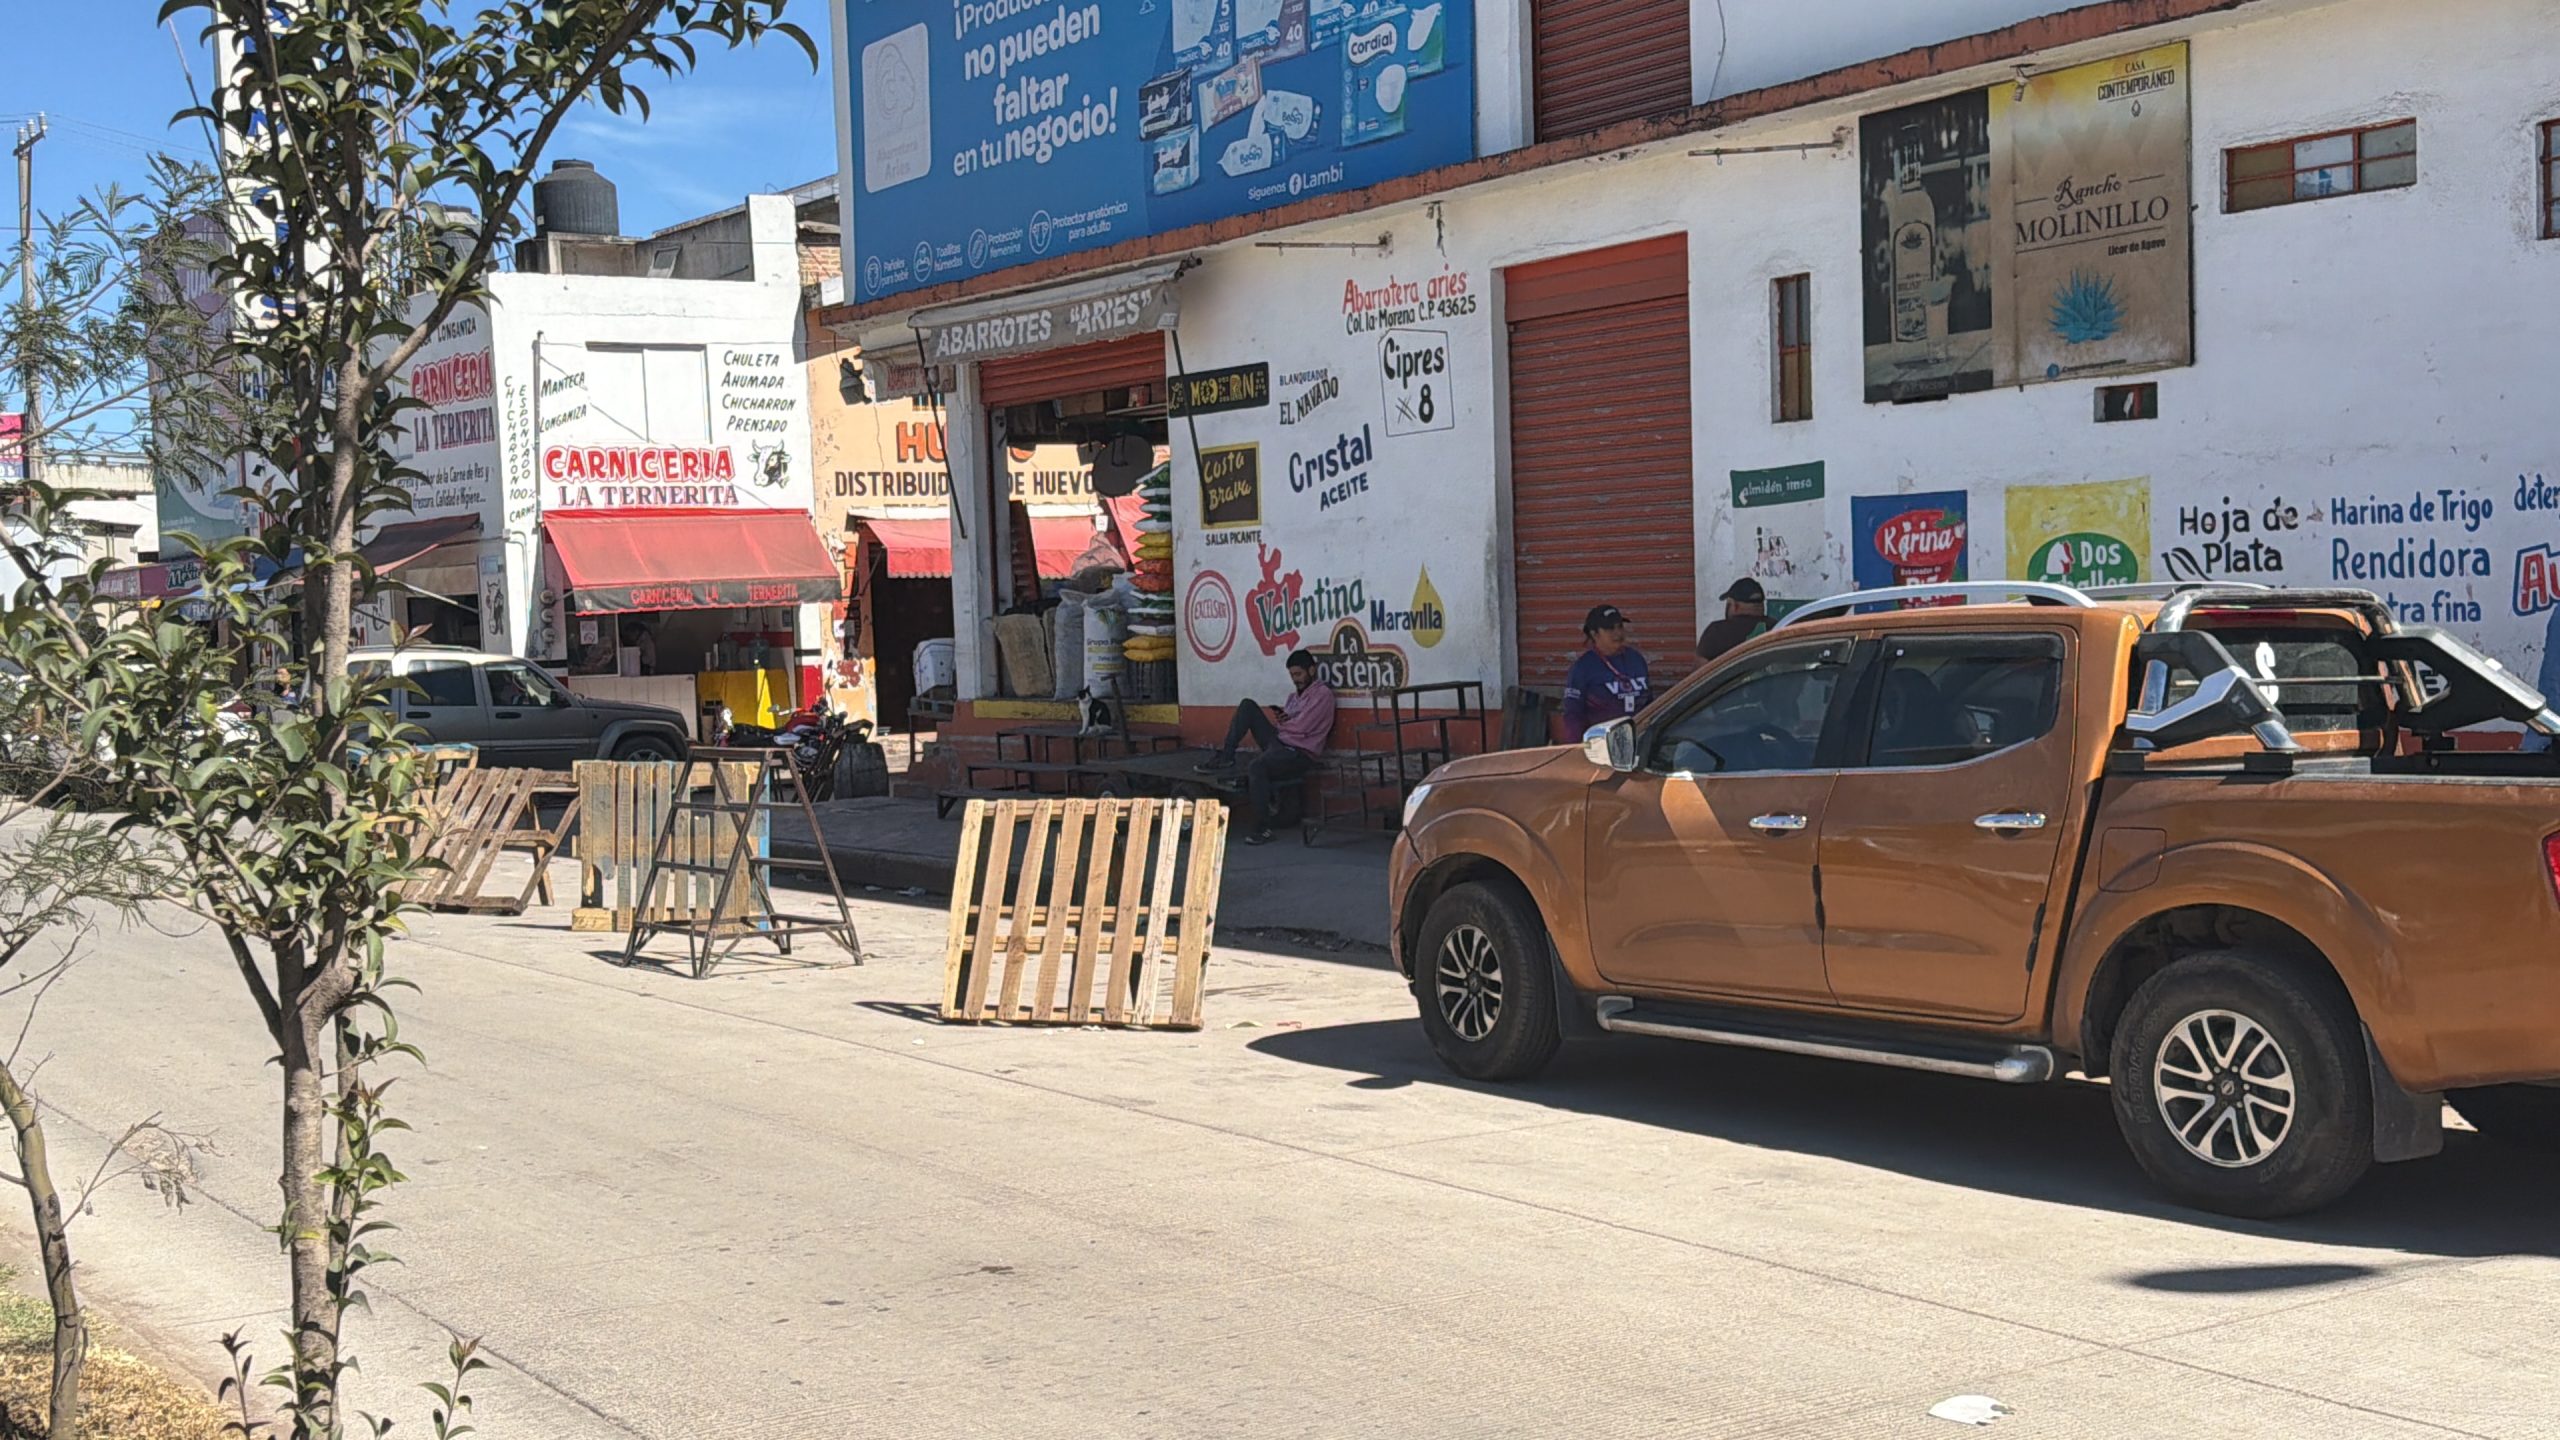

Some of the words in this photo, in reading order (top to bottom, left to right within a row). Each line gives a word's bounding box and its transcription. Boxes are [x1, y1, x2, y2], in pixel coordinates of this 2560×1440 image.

[965, 44, 995, 80] no
[1000, 3, 1099, 79] pueden
[1286, 24, 1303, 42] 40
[2125, 60, 2146, 73] CASA
[993, 72, 1069, 125] faltar
[2097, 69, 2175, 100] CONTEMPORÁNEO
[953, 149, 977, 176] en
[980, 138, 1002, 168] tu
[1005, 86, 1118, 164] negocio!
[1303, 162, 1343, 190] Lambi
[2054, 173, 2121, 211] Rancho
[1052, 212, 1086, 228] Protector
[2016, 196, 2169, 246] MOLINILLO
[2108, 245, 2127, 256] Licor
[2129, 242, 2139, 253] de
[1342, 274, 1420, 314] Abarrotera
[1427, 264, 1468, 300] aries
[1379, 308, 1415, 328] Morena
[1437, 295, 1476, 318] 43625
[935, 309, 1052, 358] ABARROTES
[723, 350, 779, 367] CHULETA
[1383, 337, 1445, 389] Cipres
[411, 350, 493, 404] CARNICERIA
[541, 372, 585, 398] MANTECA
[721, 372, 785, 389] AHUMADA
[1279, 367, 1329, 386] BLANQUEADOR
[539, 404, 587, 433] LONGANIZA
[722, 394, 796, 411] CHICHARRON
[1279, 402, 1295, 425] EL
[1418, 383, 1434, 423] 8
[414, 416, 429, 452] LA
[432, 407, 495, 450] TERNERITA
[504, 375, 520, 485] CHICHARRON
[727, 415, 788, 432] PRENSADO
[543, 446, 736, 483] CARNICERIA
[1203, 451, 1246, 484] Costa
[1289, 424, 1373, 493] Cristal
[558, 485, 593, 508] LA
[600, 485, 739, 508] TERNERITA
[1320, 471, 1369, 512] ACEITE
[1743, 480, 1783, 496] almidón
[510, 504, 535, 523] CARNE
[2179, 497, 2250, 542] Hoja
[2263, 497, 2298, 532] de
[2331, 495, 2404, 527] Harina
[2410, 491, 2434, 522] de
[2437, 489, 2493, 532] Trigo
[1205, 533, 1229, 546] SALSA
[1229, 530, 1262, 545] PICANTE
[1884, 521, 1955, 561] Karina
[2080, 541, 2121, 568] Dos
[2202, 538, 2284, 574] Plata
[2332, 538, 2491, 581] Rendidora
[631, 588, 694, 605] CARNICERIA
[705, 586, 719, 602] LA
[747, 584, 798, 600] TERNERITA
[1255, 577, 1366, 638] Valentina
[2387, 592, 2425, 624] tra
[2432, 590, 2481, 623] fina
[1370, 600, 1443, 632] Maravilla
[1340, 633, 1358, 655] La
[1313, 655, 1396, 688] osteña
